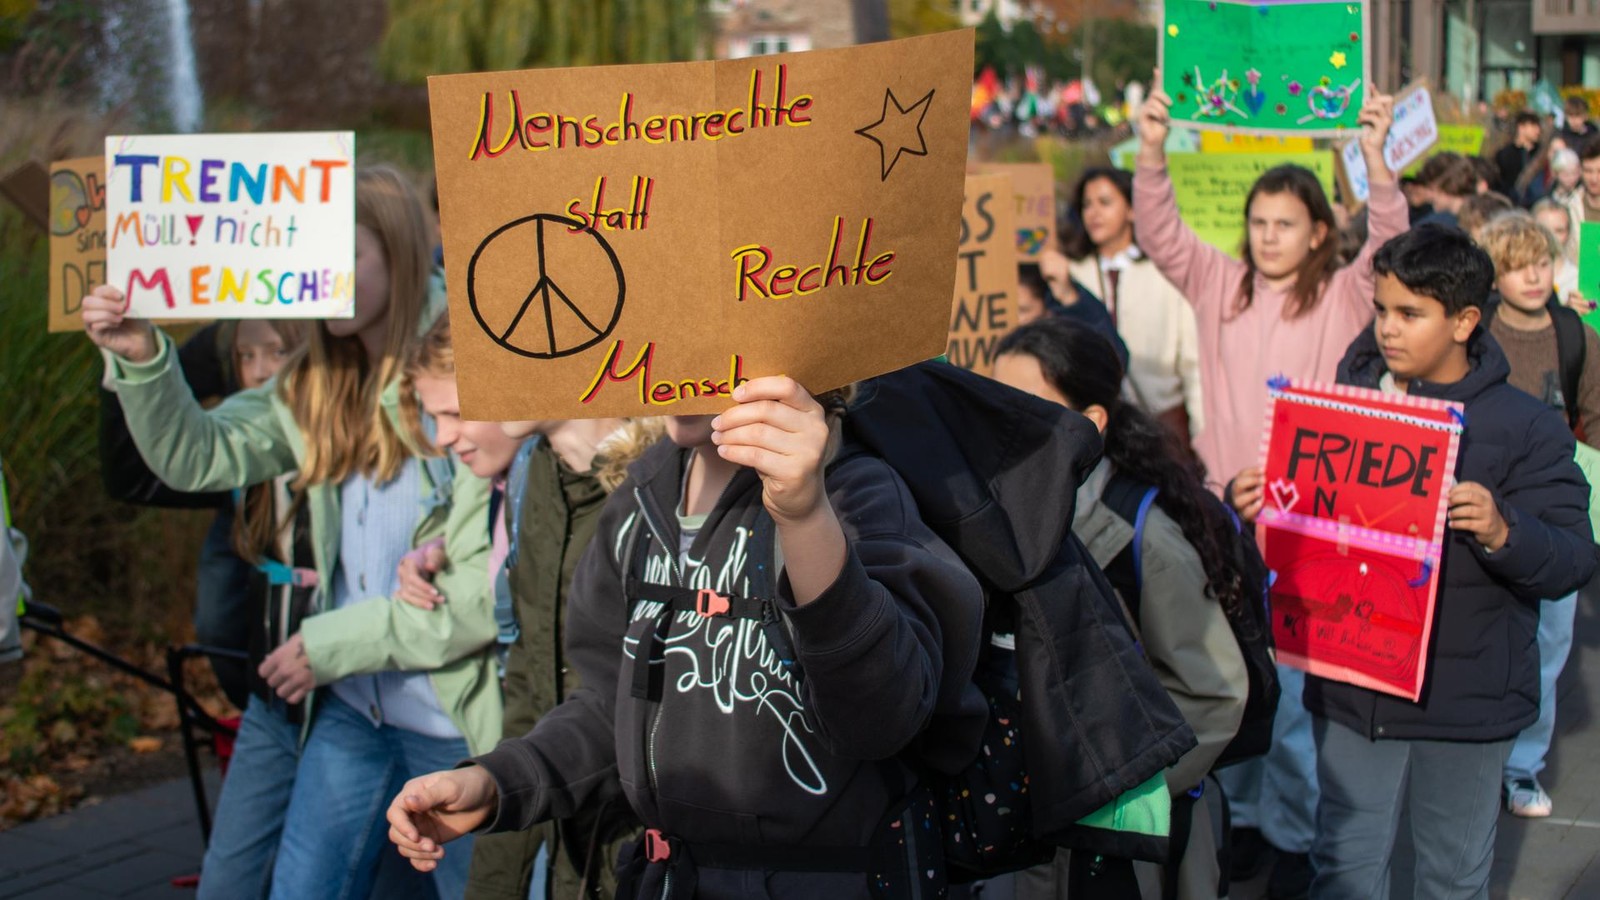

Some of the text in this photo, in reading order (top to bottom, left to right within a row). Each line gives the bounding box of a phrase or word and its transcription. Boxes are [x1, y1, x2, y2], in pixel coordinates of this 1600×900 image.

[468, 63, 813, 161] Menschenrechte
[114, 154, 349, 204] TRENNT
[565, 175, 655, 234] statt
[215, 210, 298, 247] nicht
[730, 215, 898, 301] Rechte
[124, 264, 354, 311] MENSCHEN
[1286, 427, 1438, 497] FRIEDE
[1313, 486, 1337, 518] N
